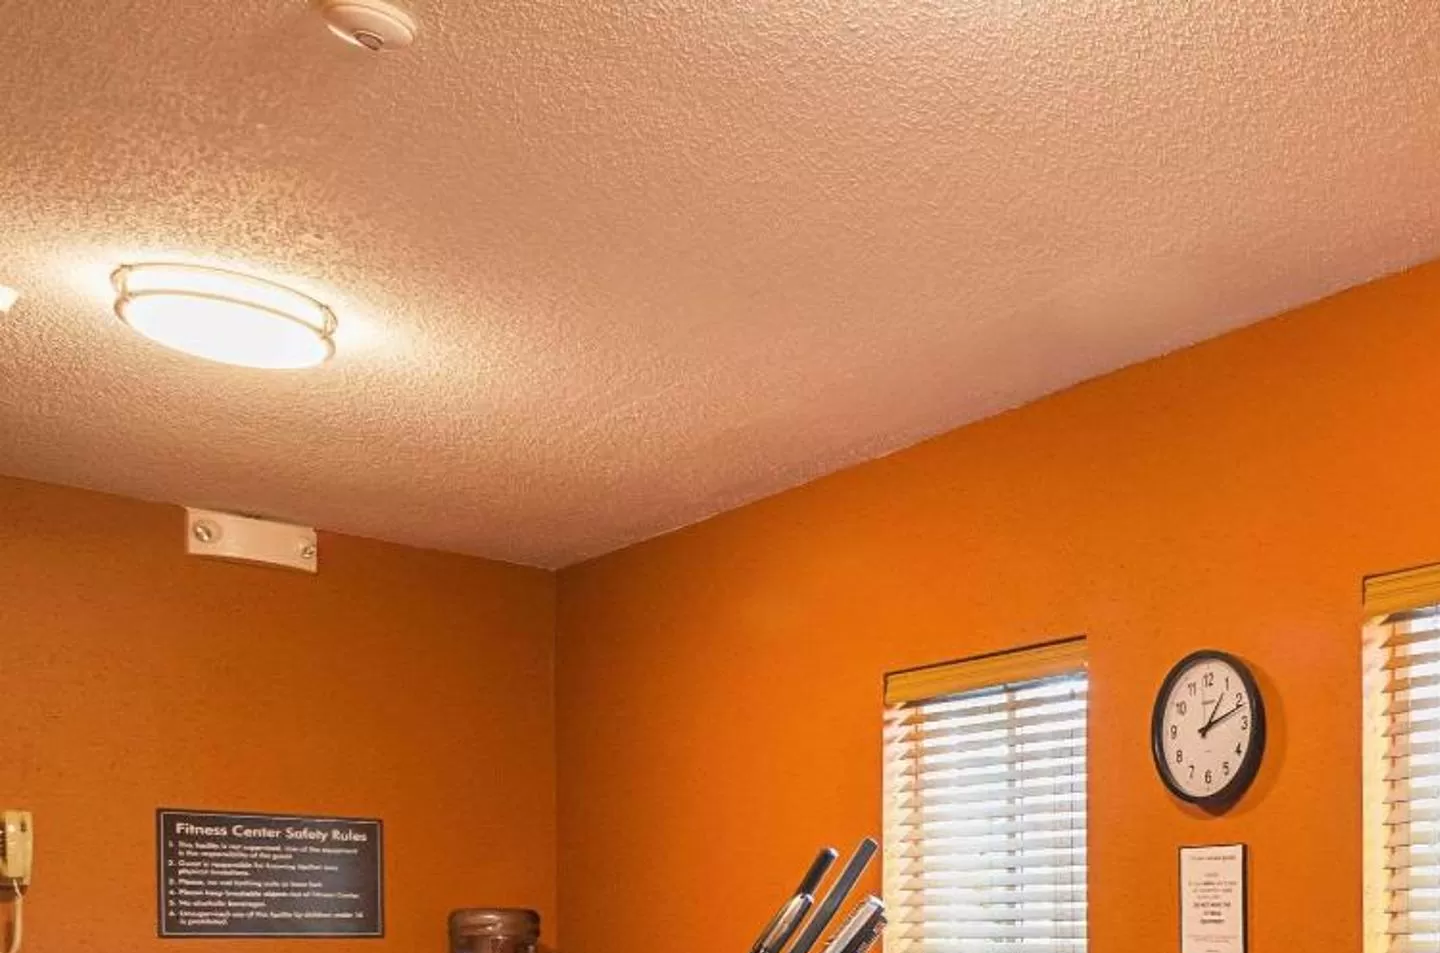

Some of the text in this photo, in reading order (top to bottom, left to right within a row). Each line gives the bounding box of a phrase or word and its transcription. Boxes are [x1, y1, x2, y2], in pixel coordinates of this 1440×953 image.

[1203, 672, 1214, 688] 12
[1187, 681, 1197, 696] 11
[1235, 692, 1243, 706] 2
[1176, 700, 1187, 716] 10
[1240, 715, 1249, 731] 3
[1170, 724, 1178, 740] 9
[1175, 750, 1183, 763] 8
[1235, 743, 1242, 756] 4
[1188, 765, 1195, 779] 7
[1222, 761, 1230, 776] 5
[1204, 769, 1213, 784] 6
[176, 823, 367, 842] Fitness Center Safety Rules
